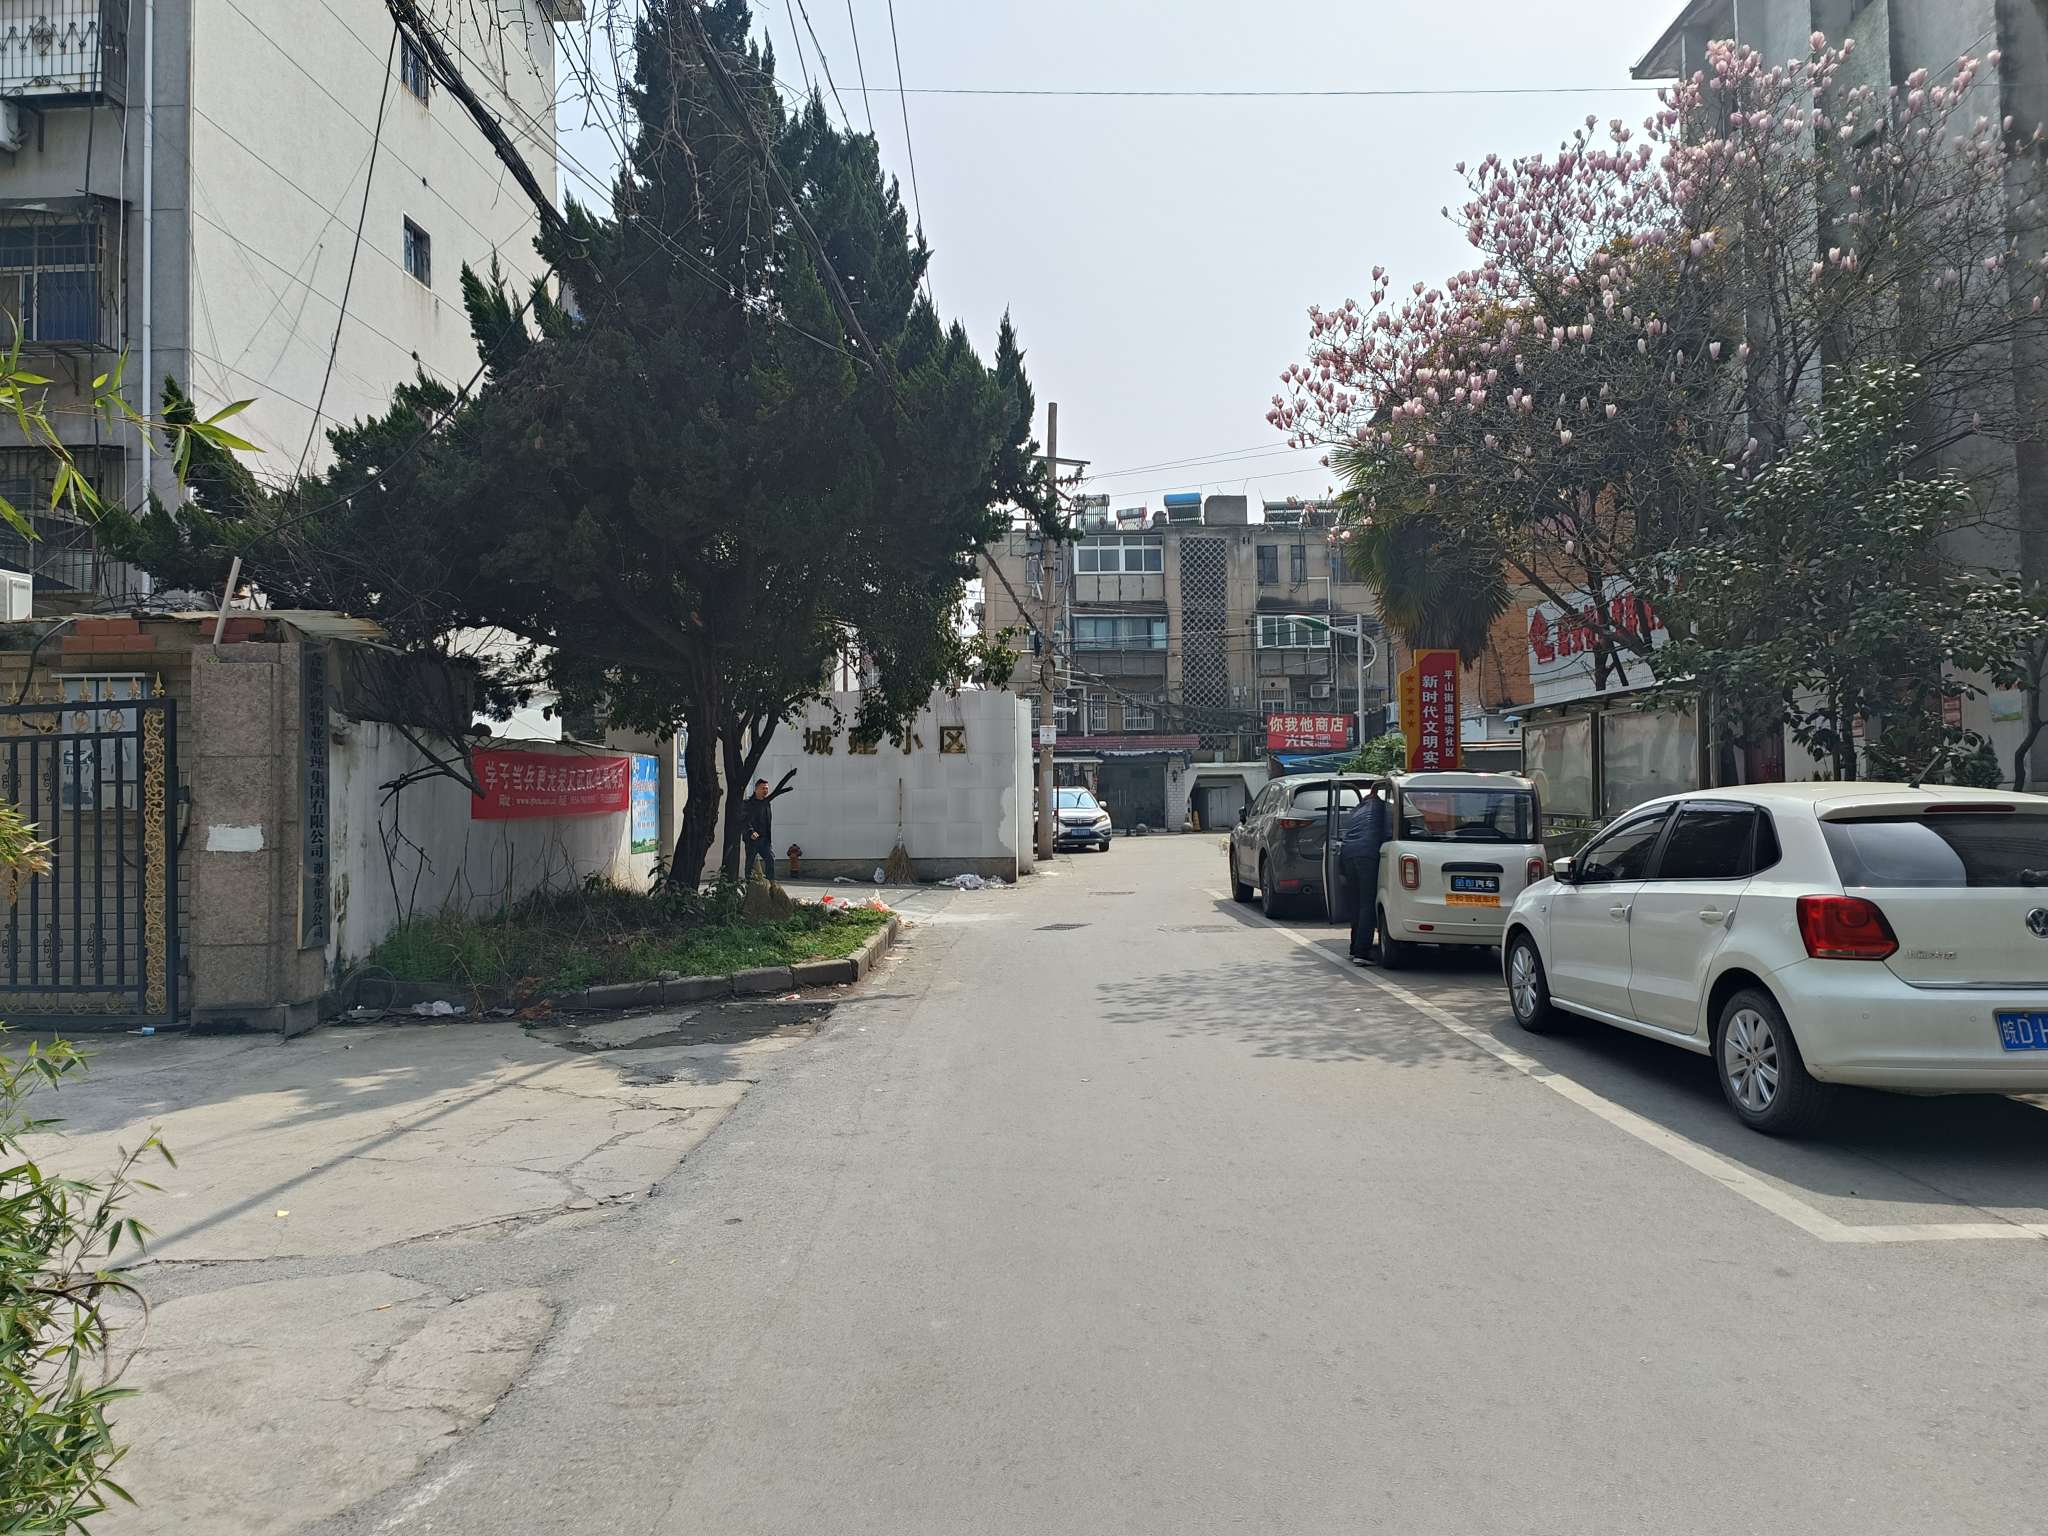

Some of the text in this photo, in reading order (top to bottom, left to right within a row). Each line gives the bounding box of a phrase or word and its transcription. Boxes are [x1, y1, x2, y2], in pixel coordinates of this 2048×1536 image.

[1269, 716, 1344, 732] 你我他商店
[1422, 675, 1439, 769] 新时代文明实
